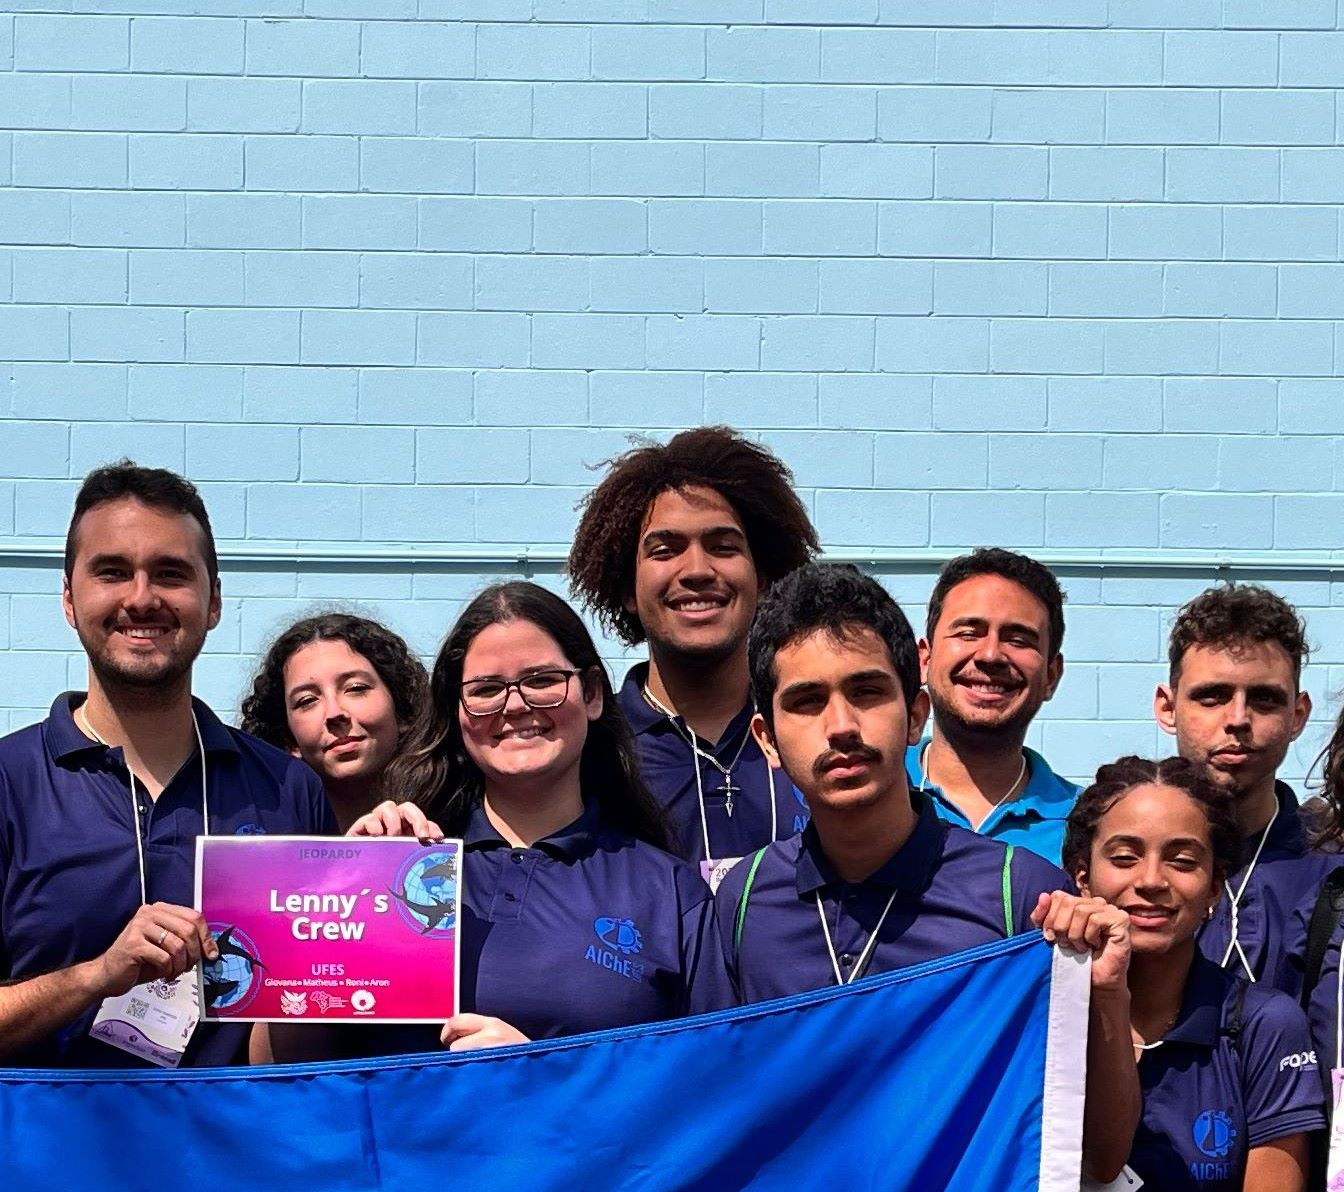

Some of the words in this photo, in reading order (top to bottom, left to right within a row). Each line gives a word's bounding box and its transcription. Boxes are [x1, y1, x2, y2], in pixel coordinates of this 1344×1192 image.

[299, 848, 362, 859] JEOPARDY
[292, 917, 365, 940] Crew
[311, 963, 344, 976] UFES
[584, 944, 632, 978] AIChE
